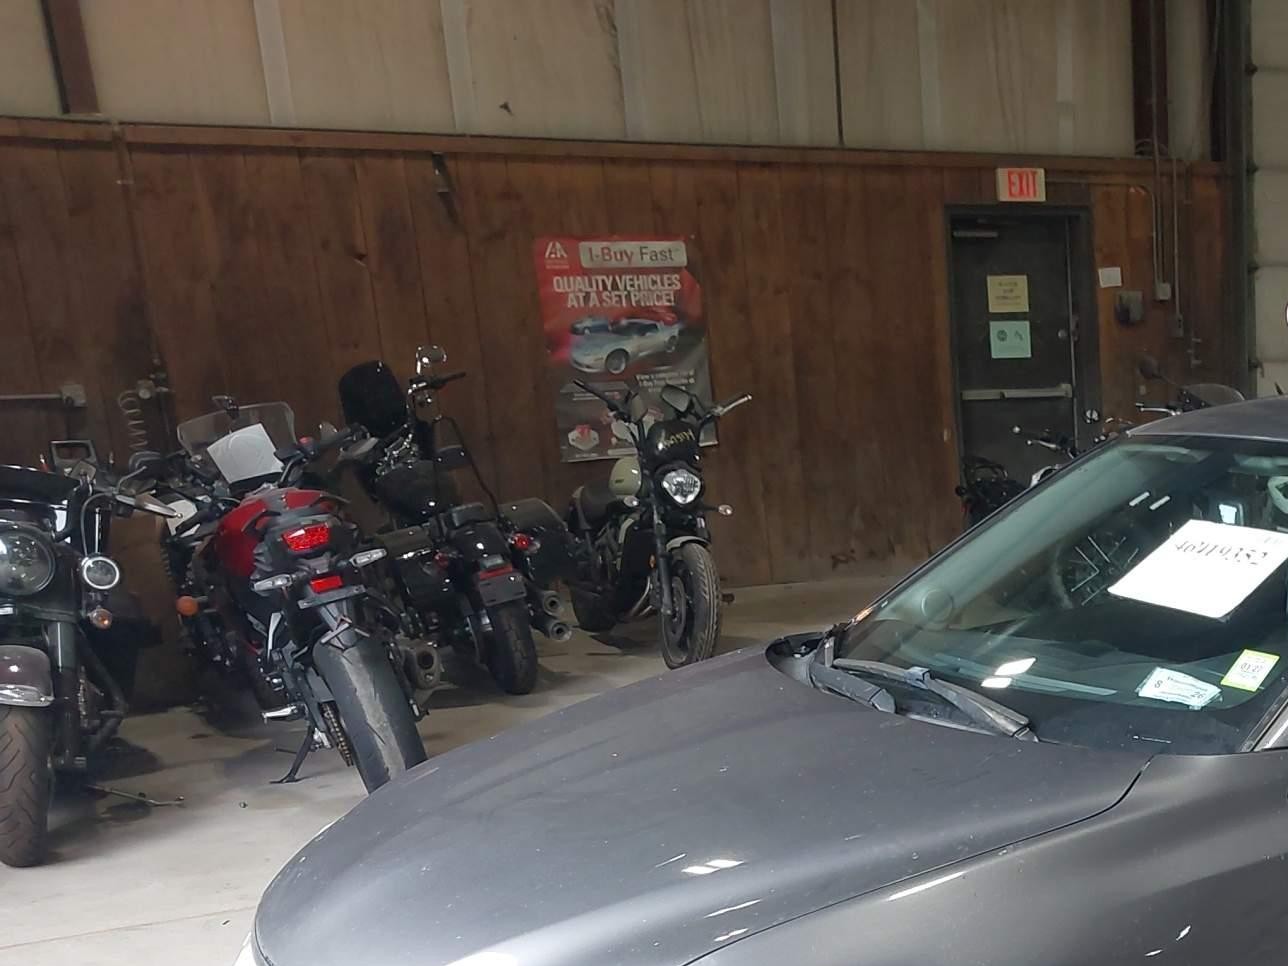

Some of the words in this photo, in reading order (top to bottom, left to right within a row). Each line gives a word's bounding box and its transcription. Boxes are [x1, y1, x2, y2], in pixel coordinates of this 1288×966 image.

[1007, 170, 1038, 198] EXIT
[589, 246, 634, 264] I-Buy
[640, 246, 675, 262] Fast
[553, 275, 614, 293] QUALITY
[615, 273, 682, 291] VEHICLES
[567, 293, 586, 308] AT
[588, 292, 600, 308] A
[601, 292, 628, 307] SET
[630, 290, 676, 308] PRICE!
